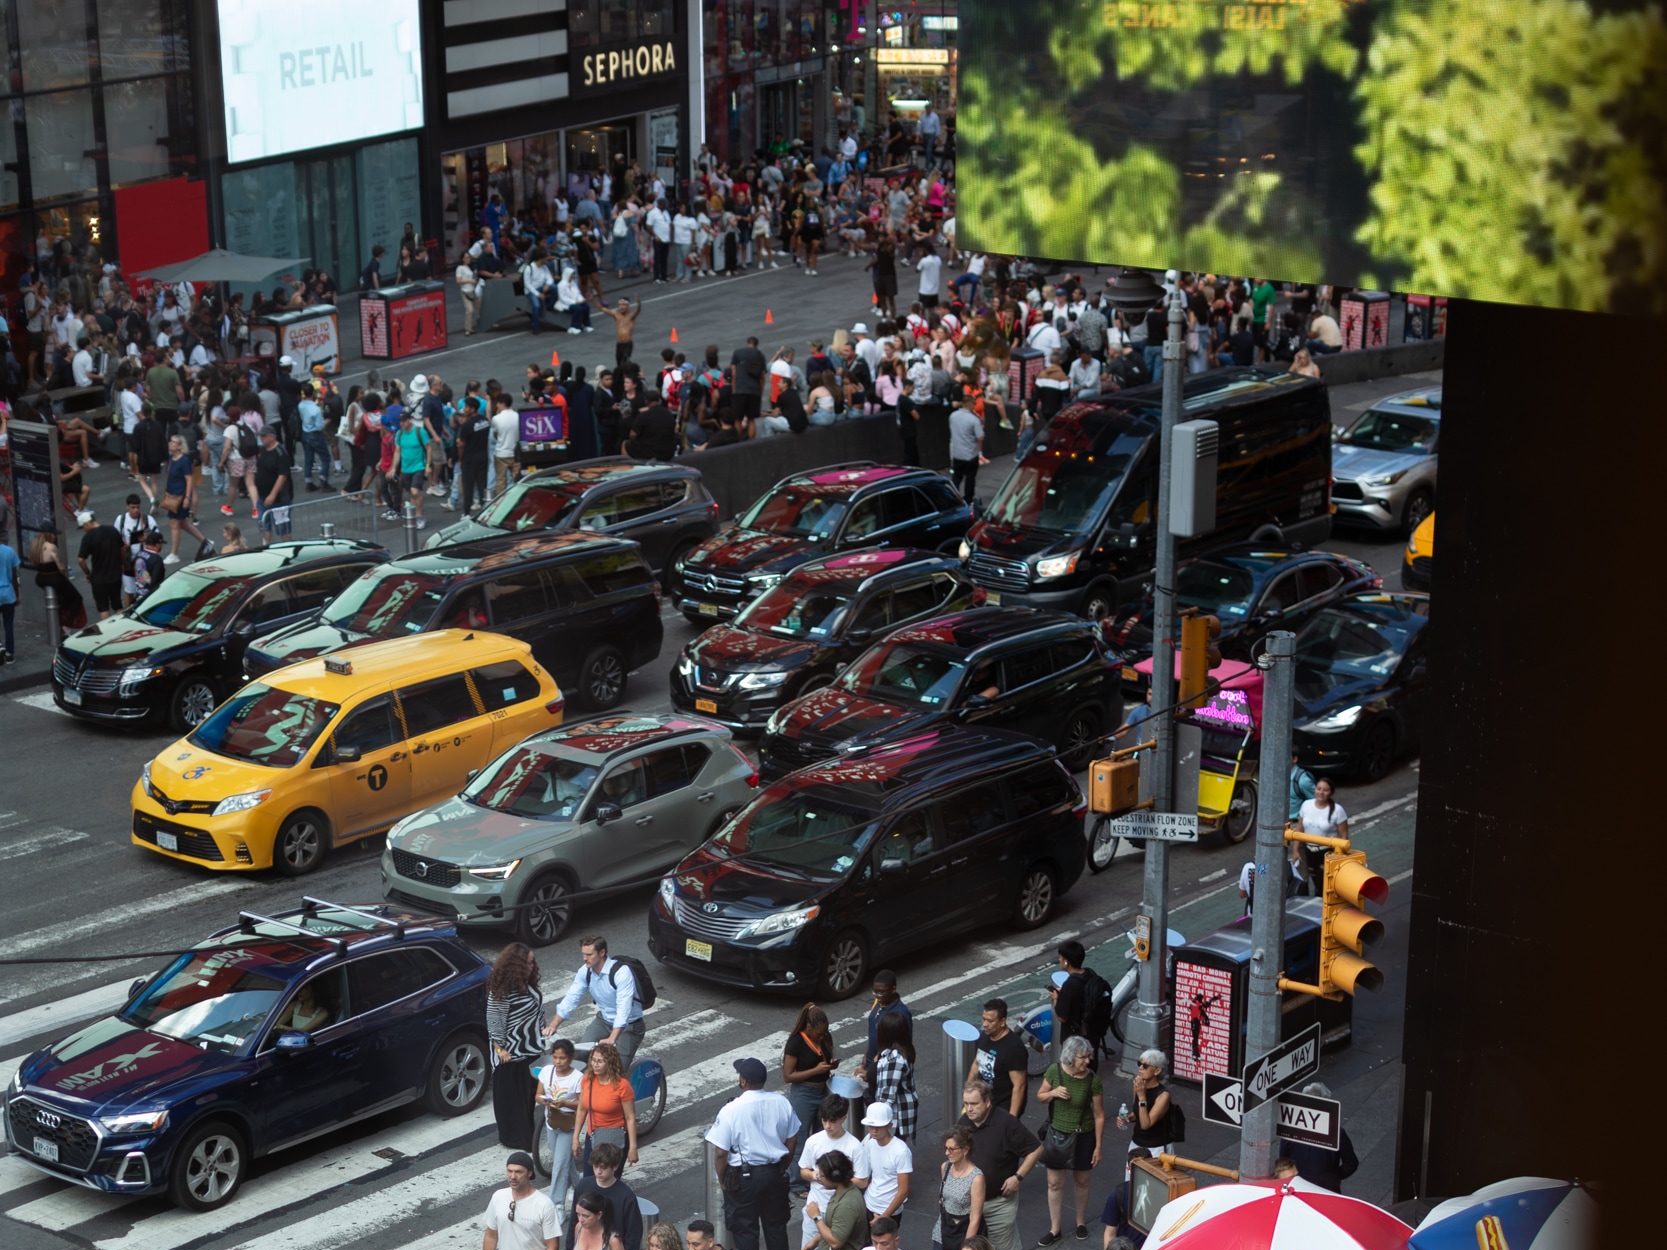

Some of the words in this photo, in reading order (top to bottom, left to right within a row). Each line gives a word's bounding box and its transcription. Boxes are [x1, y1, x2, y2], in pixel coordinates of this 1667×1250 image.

[280, 41, 374, 90] RETAIL
[583, 41, 676, 86] SEPHORA
[288, 323, 319, 339] CLOSER
[319, 321, 329, 333] TO
[492, 710, 508, 720] 7021
[371, 769, 384, 788] T
[1157, 815, 1176, 826] FLOW
[1177, 816, 1197, 827] ZONE
[1112, 824, 1131, 835] KEEP
[1131, 825, 1159, 837] MOVING
[1176, 969, 1201, 980] SMOOTH
[1193, 965, 1206, 973] BAD
[1209, 968, 1231, 978] MONEY
[1175, 1034, 1194, 1042] BEAT
[1207, 1042, 1228, 1050] ABC
[1202, 1047, 1228, 1058] NATURE
[1256, 1063, 1278, 1092] ONE
[1291, 1042, 1313, 1071] WAY
[1280, 1104, 1321, 1130] WAY
